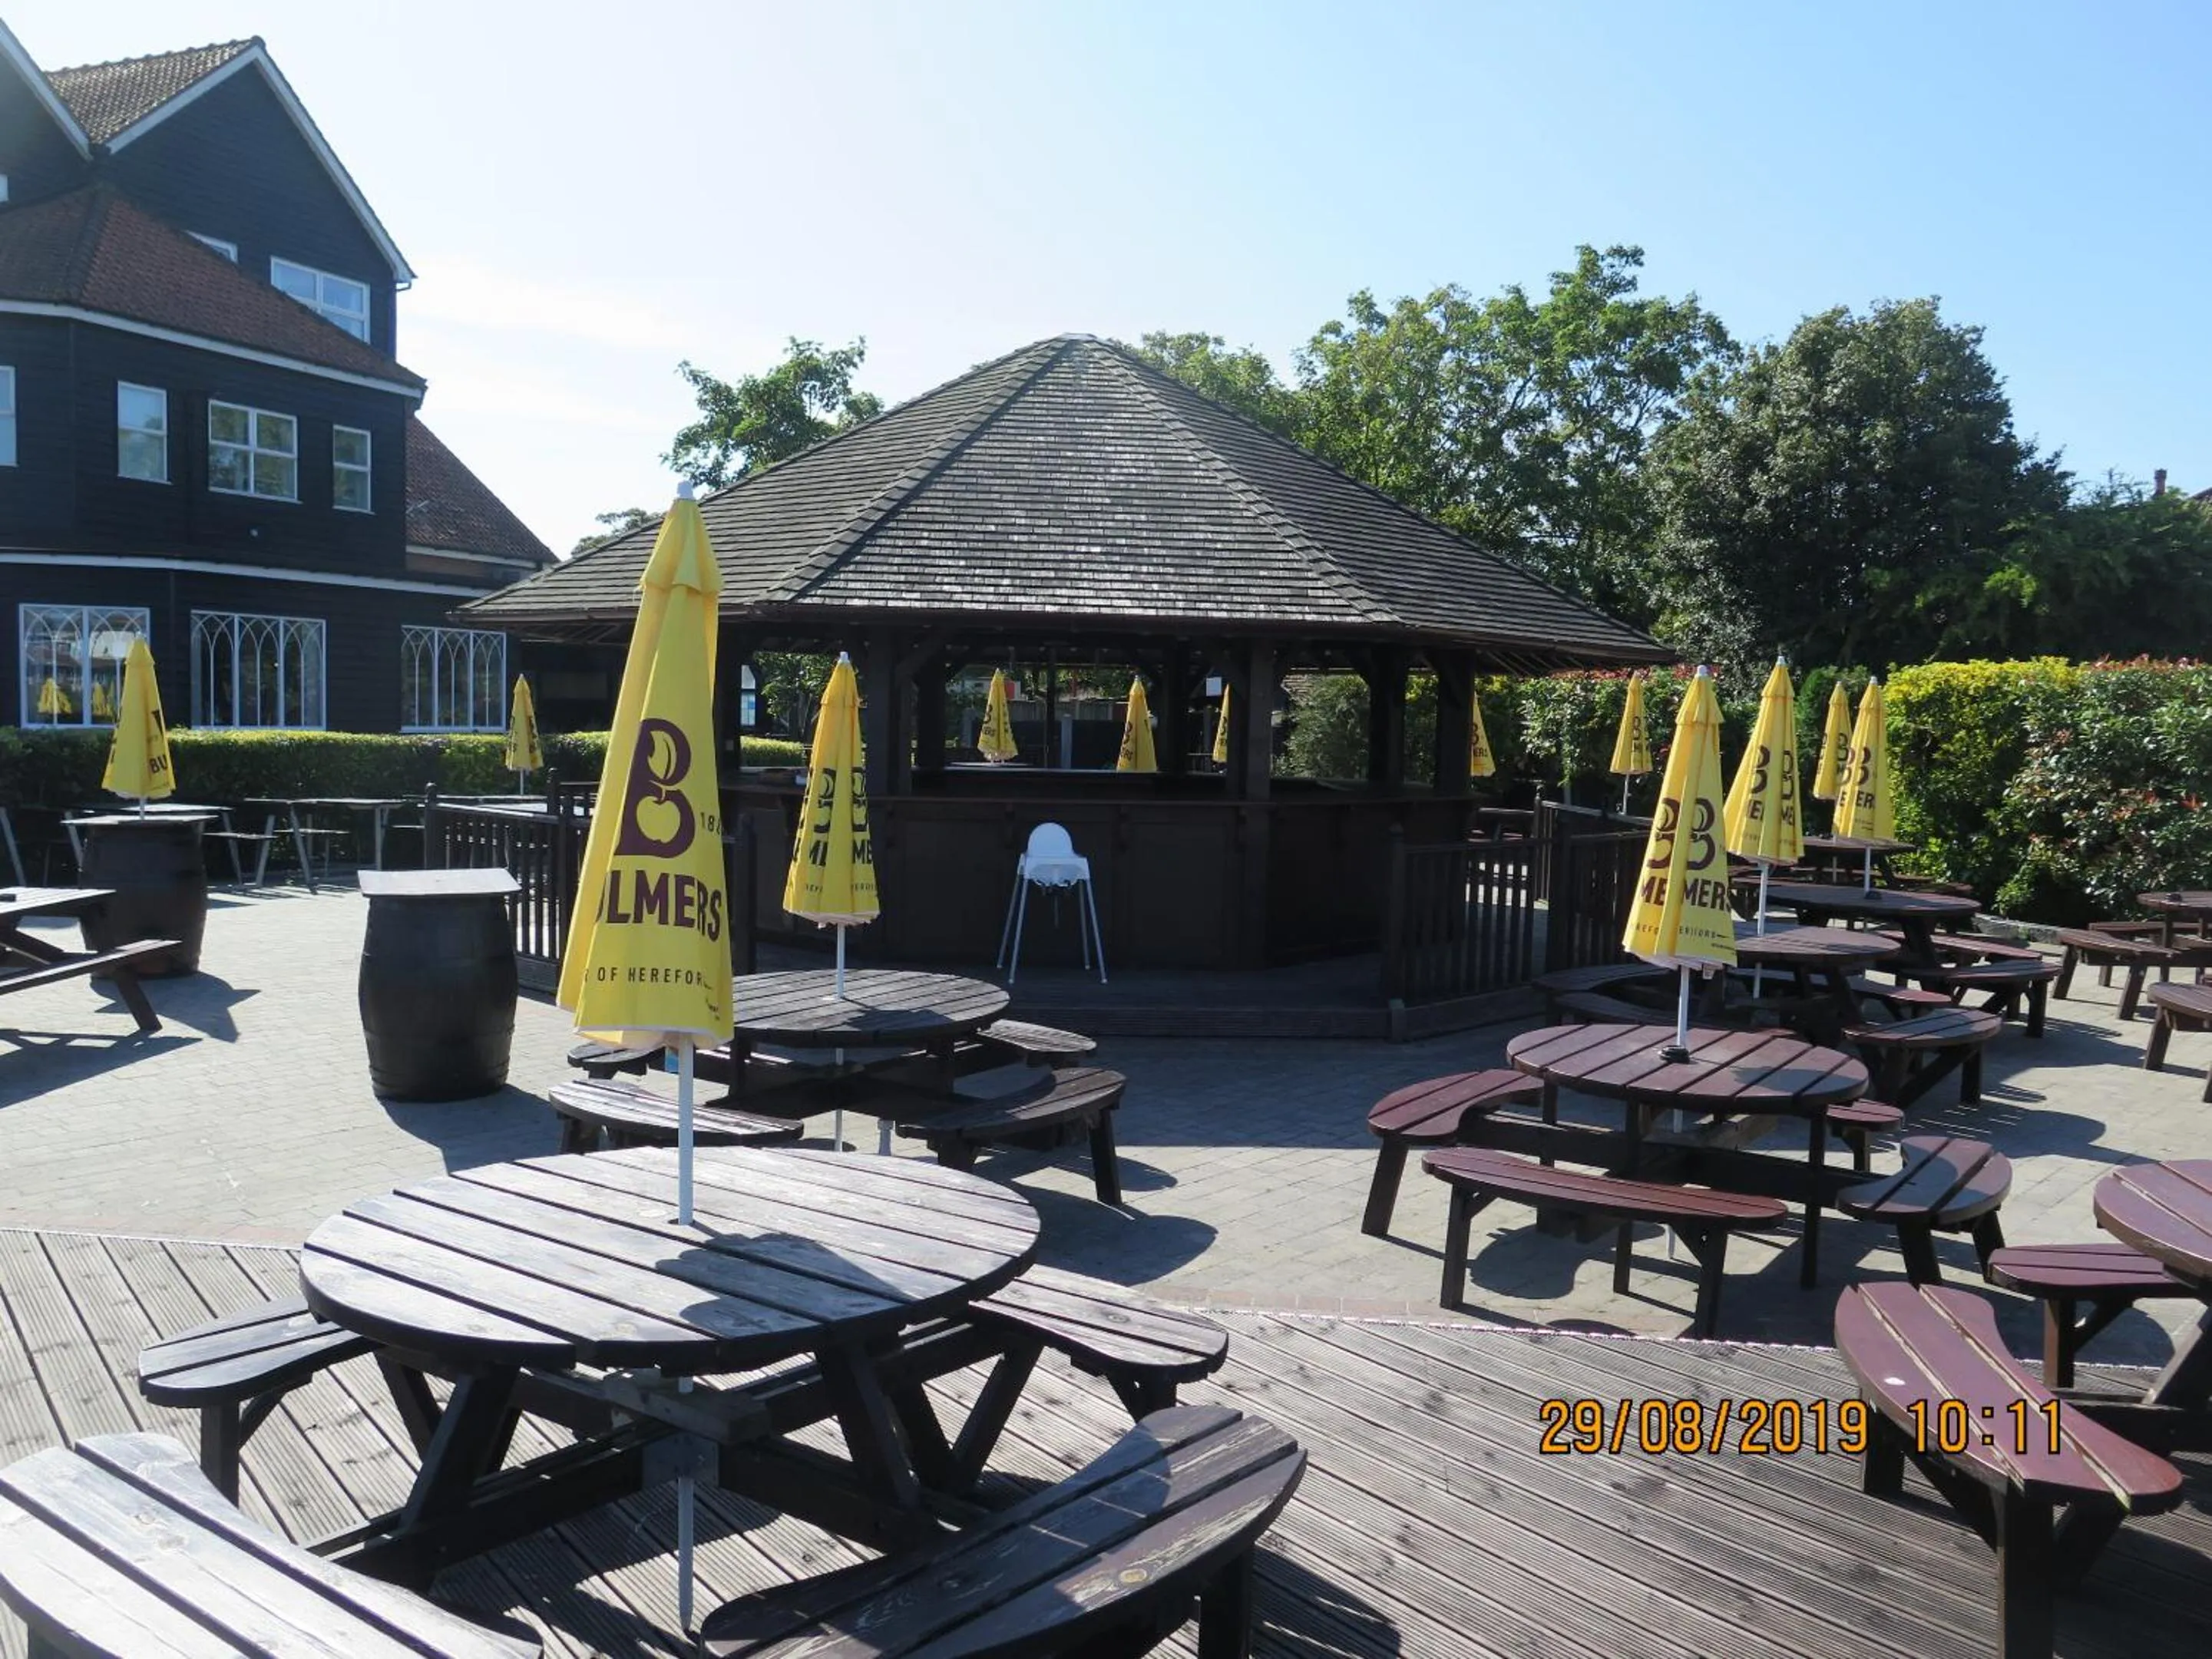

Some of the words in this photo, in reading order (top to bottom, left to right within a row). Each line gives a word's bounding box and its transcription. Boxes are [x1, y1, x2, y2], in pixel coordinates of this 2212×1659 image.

[595, 869, 722, 942] LMERS
[597, 967, 617, 981] OF
[628, 967, 705, 986] HEREFOR
